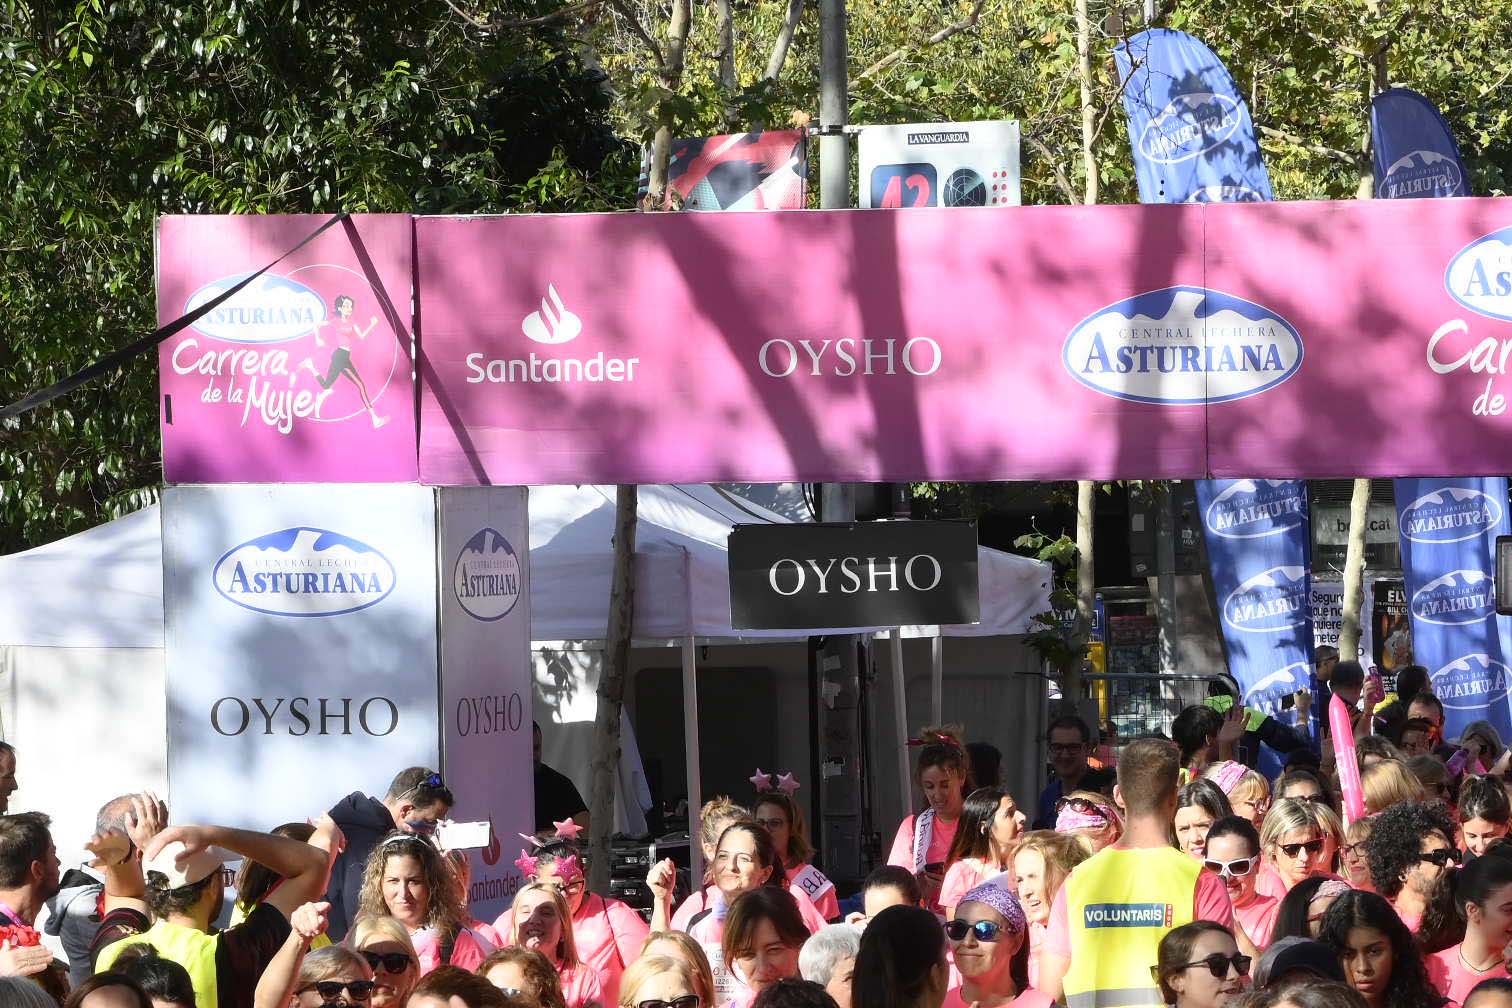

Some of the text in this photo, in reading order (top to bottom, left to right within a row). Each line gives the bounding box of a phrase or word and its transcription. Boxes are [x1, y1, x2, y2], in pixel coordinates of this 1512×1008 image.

[919, 132, 967, 143] VANGUARDIA
[1118, 326, 1277, 339] CENTRAL LECHERA
[171, 338, 289, 376] Carrera
[466, 351, 639, 384] Santander
[758, 336, 942, 377] OYSHO
[1083, 337, 1283, 375] ASTURIANA
[200, 375, 334, 434] de la Mujer
[1472, 374, 1506, 417] de
[228, 560, 383, 594] ASTURIANA
[318, 558, 374, 567] LECHE
[459, 562, 518, 598] ASTURIANA
[769, 554, 942, 596] OYSHO
[1387, 590, 1407, 602] ELV
[1313, 619, 1345, 632] quiere
[210, 696, 399, 737] OYSHO
[456, 692, 522, 737] OYSHO
[1085, 908, 1163, 922] VOLUNTARIS
